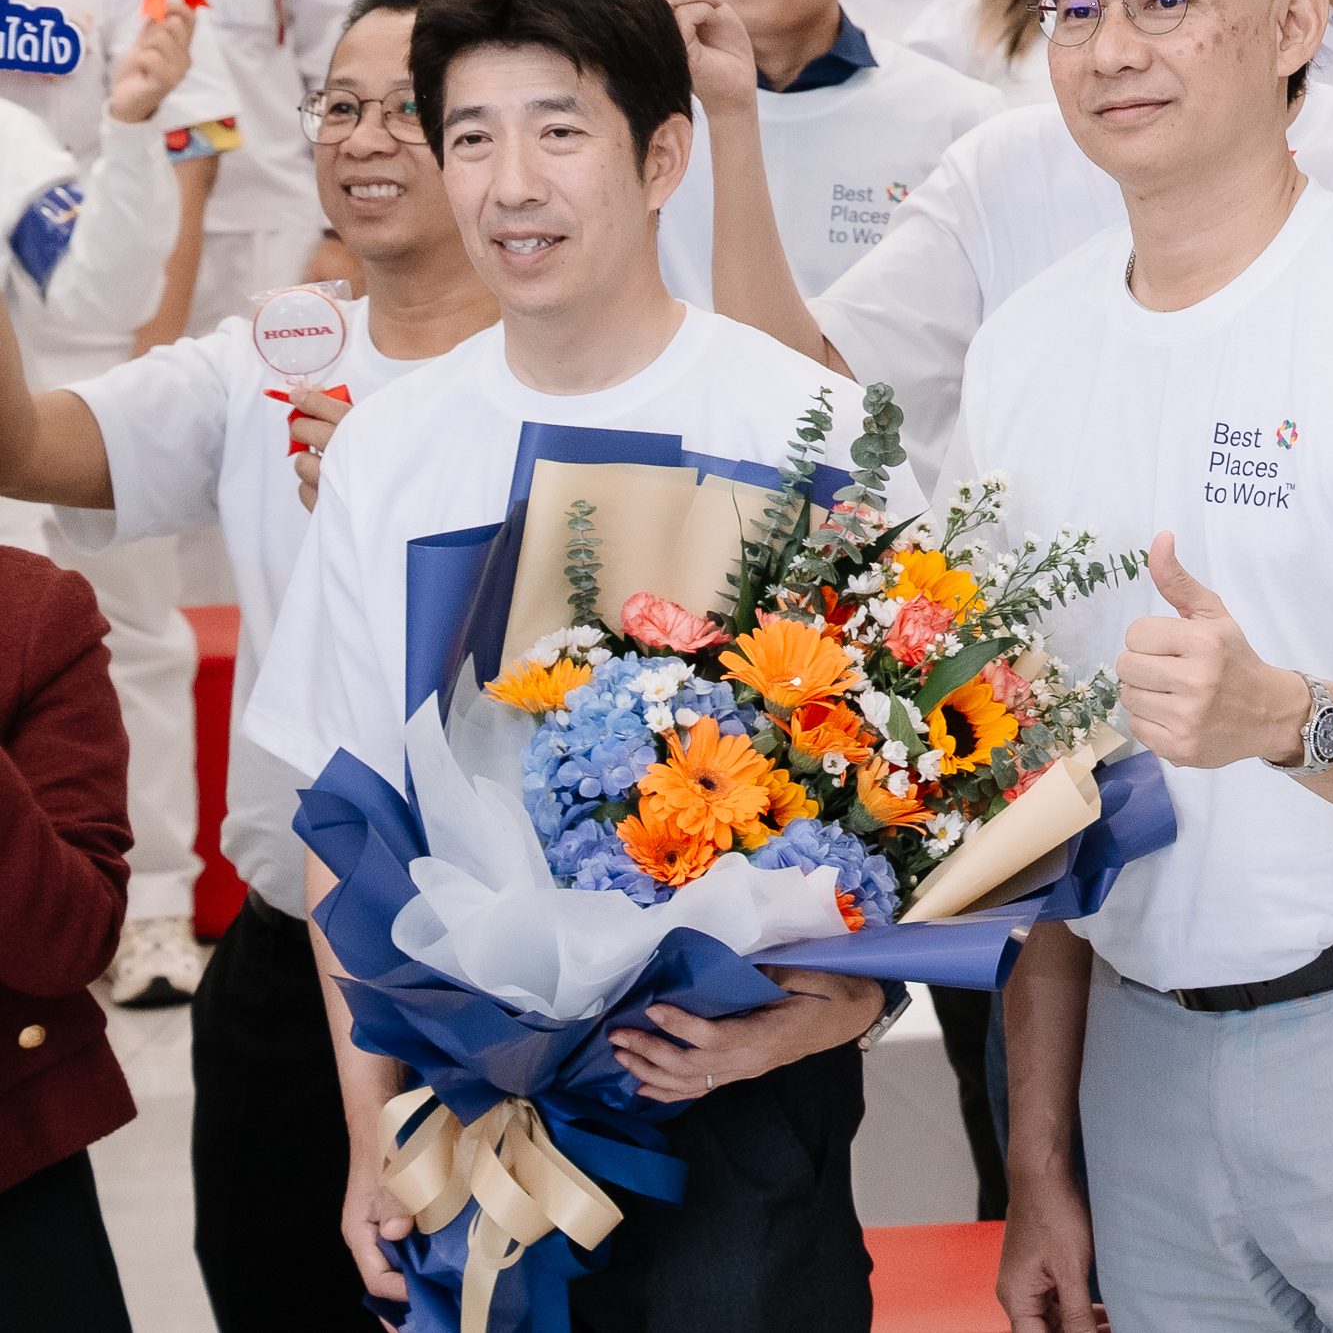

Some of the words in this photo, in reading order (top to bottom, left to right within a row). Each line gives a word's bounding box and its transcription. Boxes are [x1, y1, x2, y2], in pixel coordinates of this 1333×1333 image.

[0, 15, 73, 65] ได้ไง
[833, 184, 874, 203] Best
[830, 205, 891, 225] Places
[829, 229, 848, 244] to
[852, 227, 884, 245] Wo
[263, 324, 335, 341] HONDA
[1214, 422, 1262, 448] Best
[1208, 451, 1279, 478] Places
[1204, 482, 1227, 504] to
